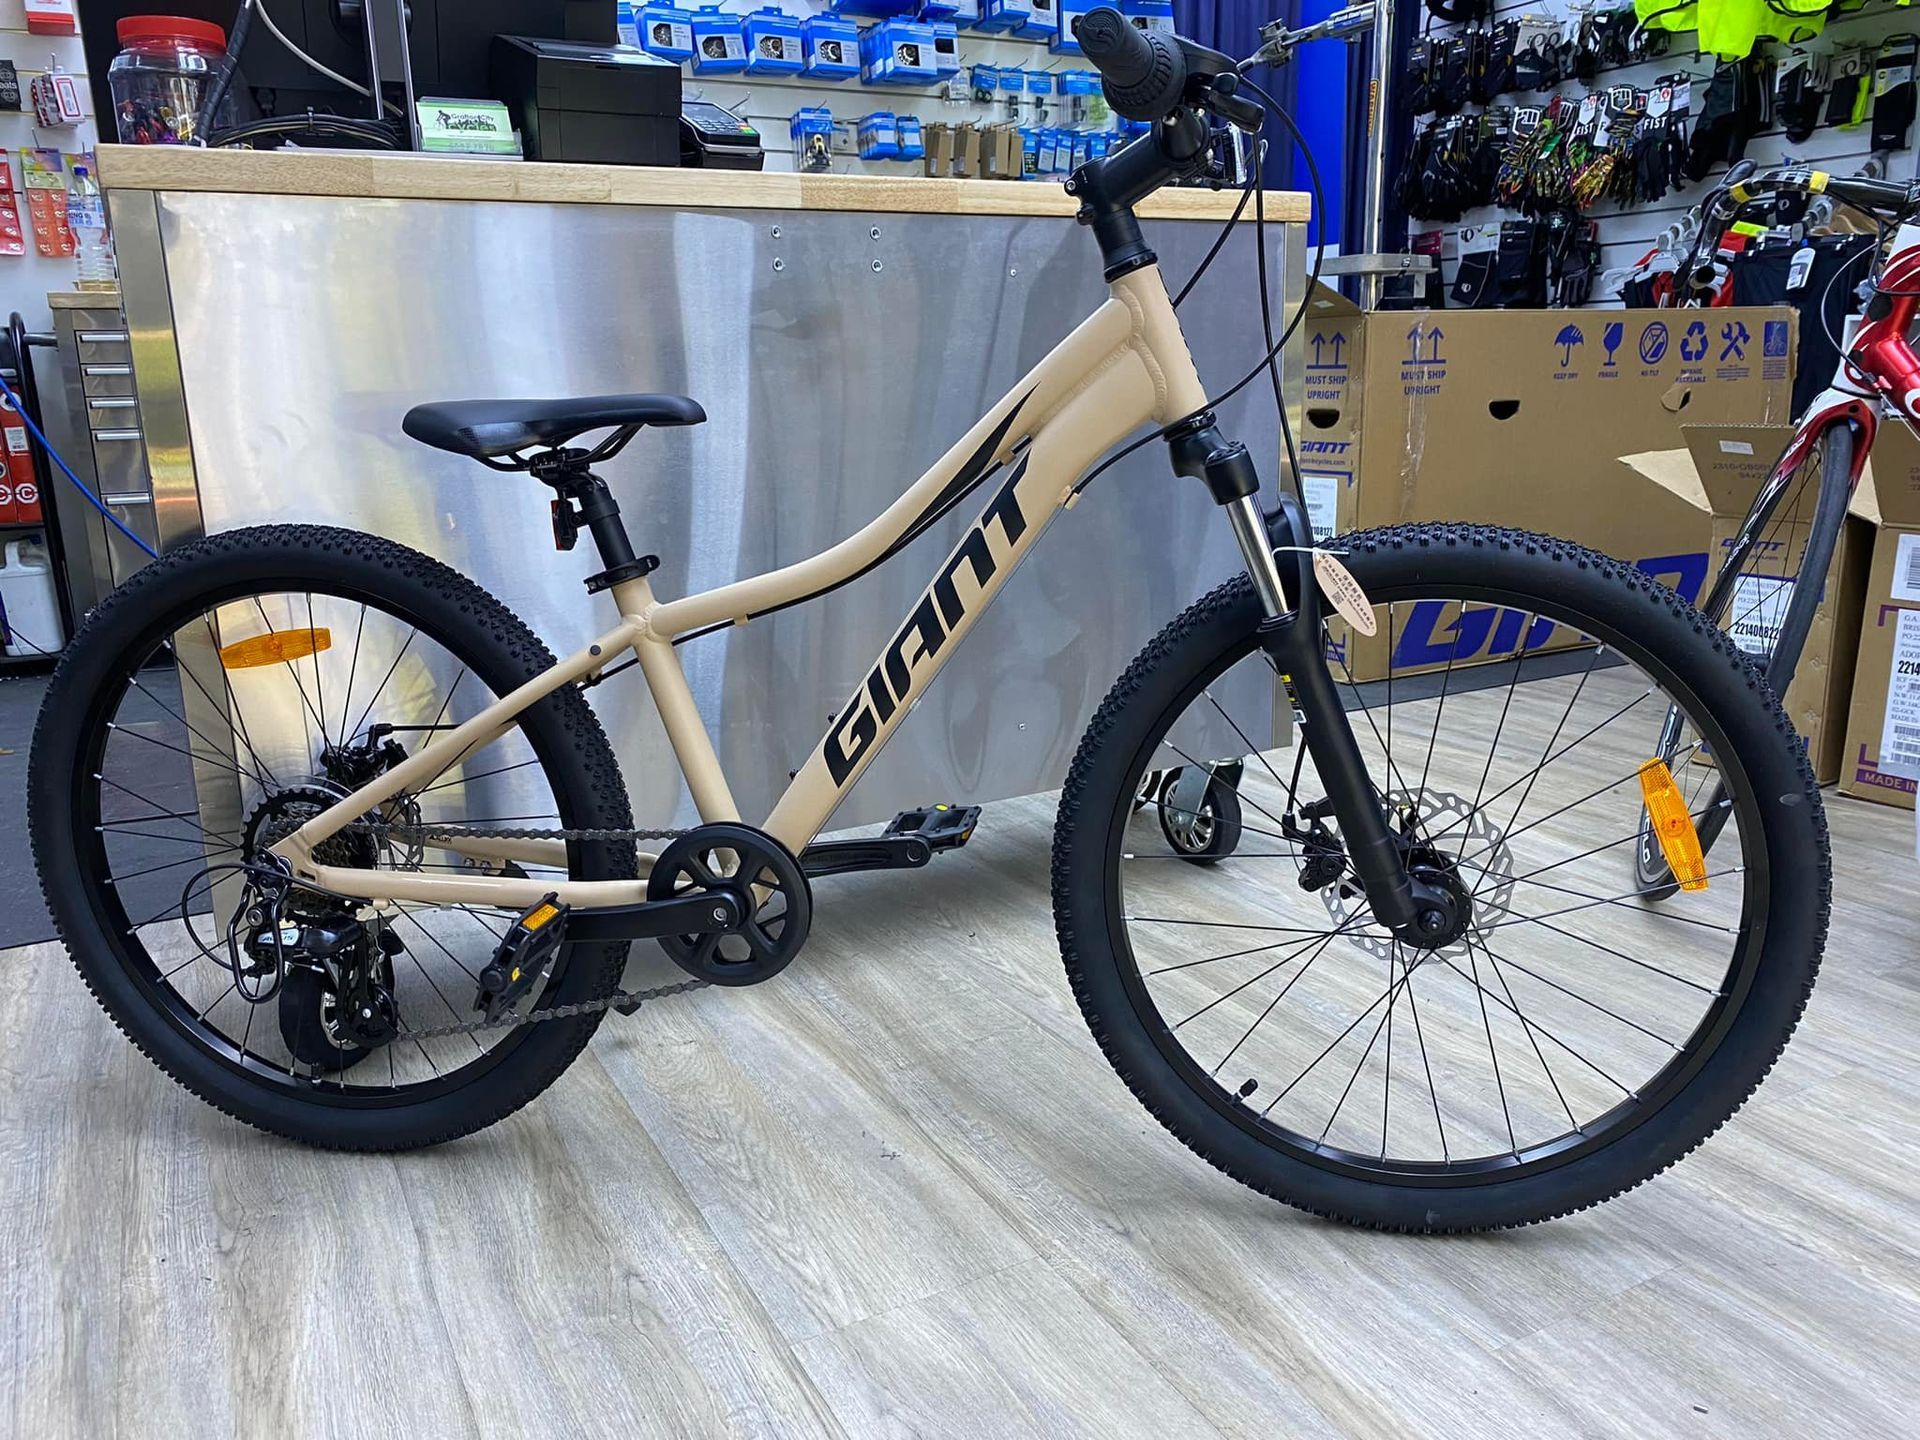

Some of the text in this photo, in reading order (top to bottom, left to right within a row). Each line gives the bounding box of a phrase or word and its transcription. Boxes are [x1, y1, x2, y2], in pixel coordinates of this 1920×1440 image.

[1576, 123, 1594, 135] FIST
[1643, 117, 1667, 130] FIST
[1305, 375, 1347, 385] MUST SHIP
[1401, 370, 1447, 381] MUST SHIP
[1307, 390, 1341, 400] UPRIGHT
[1404, 385, 1441, 396] UPRIGHT
[823, 446, 1034, 789] GIANT
[1864, 772, 1917, 792] MADE IN
